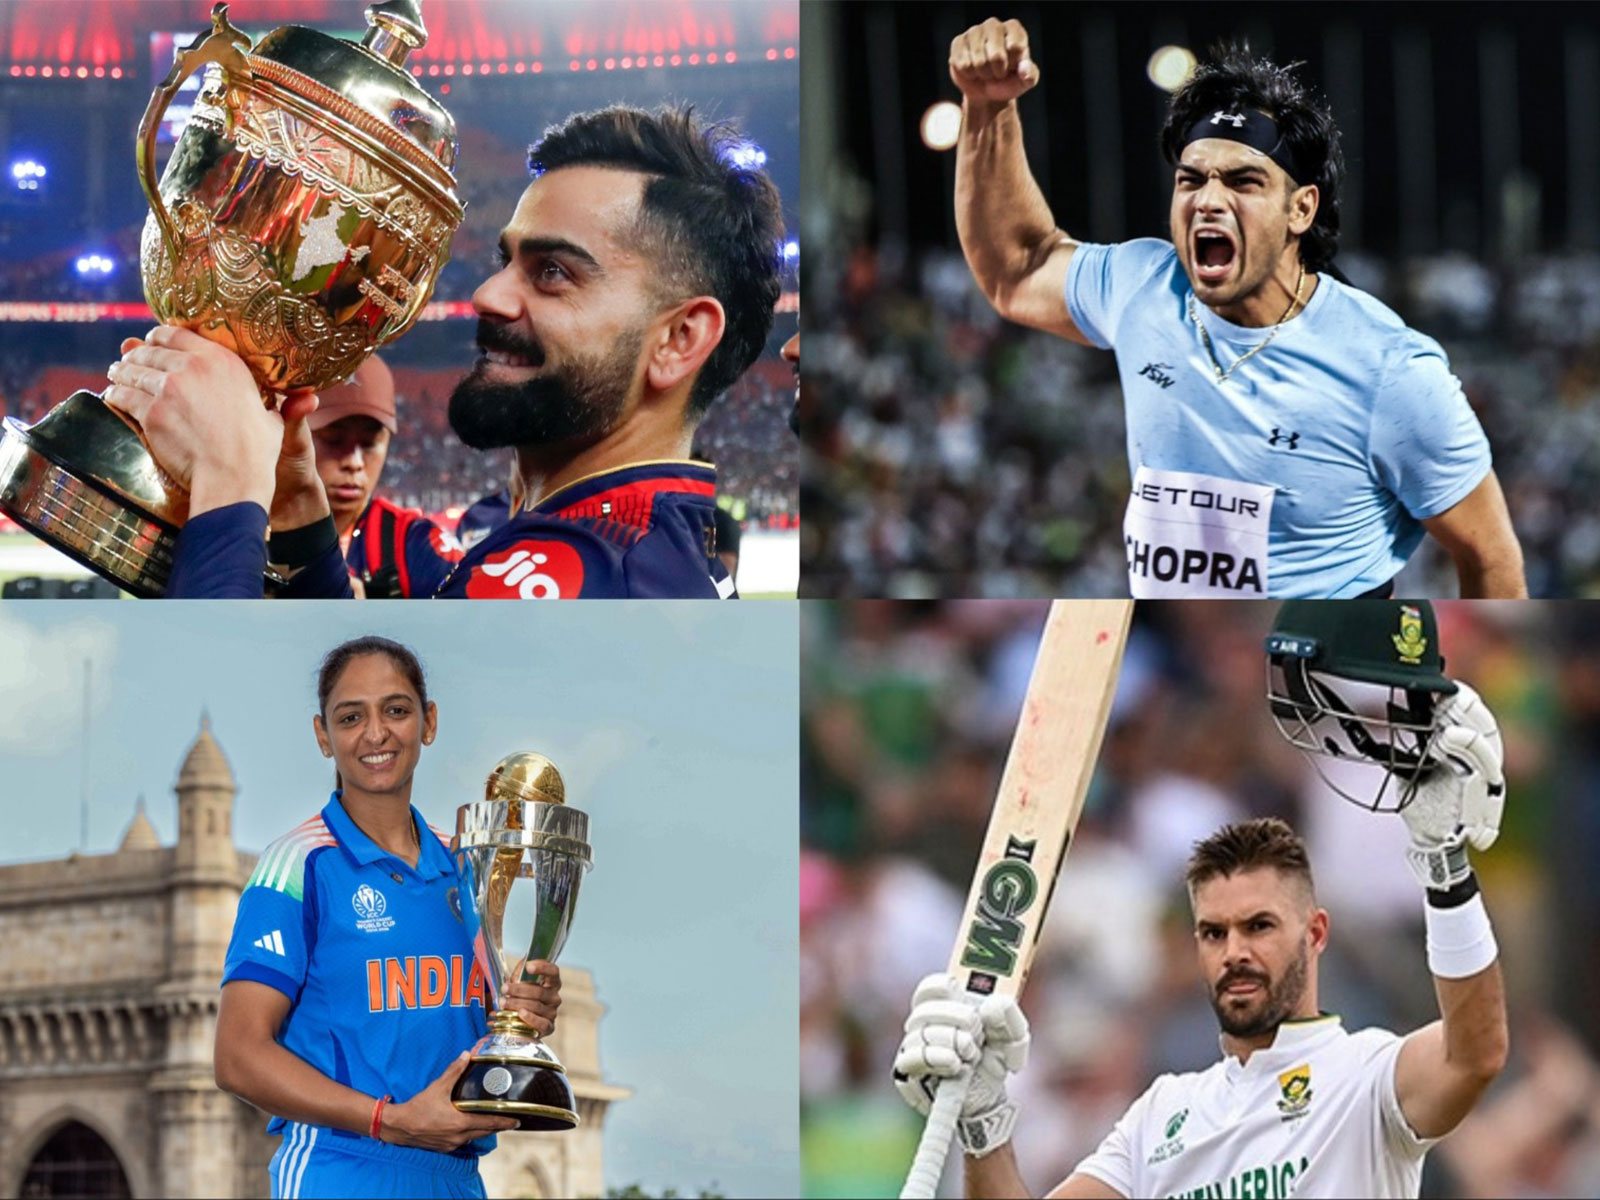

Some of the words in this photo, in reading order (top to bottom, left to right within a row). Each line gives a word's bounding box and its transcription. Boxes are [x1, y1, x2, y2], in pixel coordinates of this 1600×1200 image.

[1137, 362, 1175, 389] JSW
[1127, 534, 1263, 593] HOPRA
[382, 919, 396, 928] CUP
[960, 858, 1038, 977] GM
[366, 954, 486, 1013] INDIA
